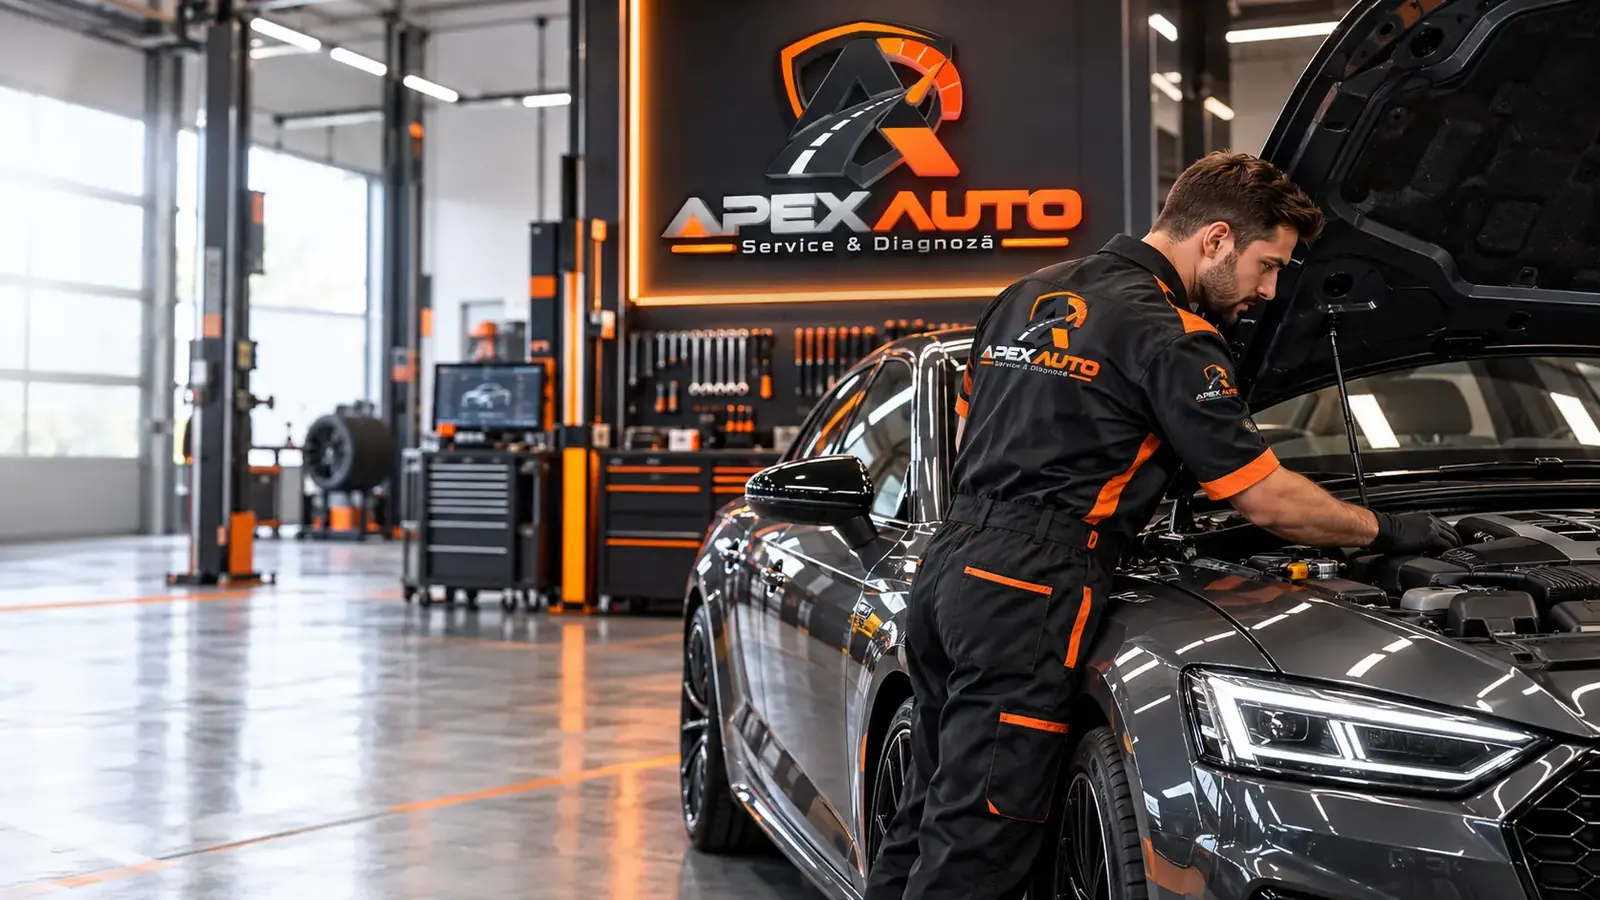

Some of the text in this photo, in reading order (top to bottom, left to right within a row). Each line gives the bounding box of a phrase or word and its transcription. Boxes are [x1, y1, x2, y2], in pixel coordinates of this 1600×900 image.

[661, 188, 1083, 237] APEX AUTO
[742, 239, 834, 254] Service
[847, 236, 862, 252] &
[980, 345, 1100, 377] APEX AUTO
[1196, 389, 1222, 400] APEX
